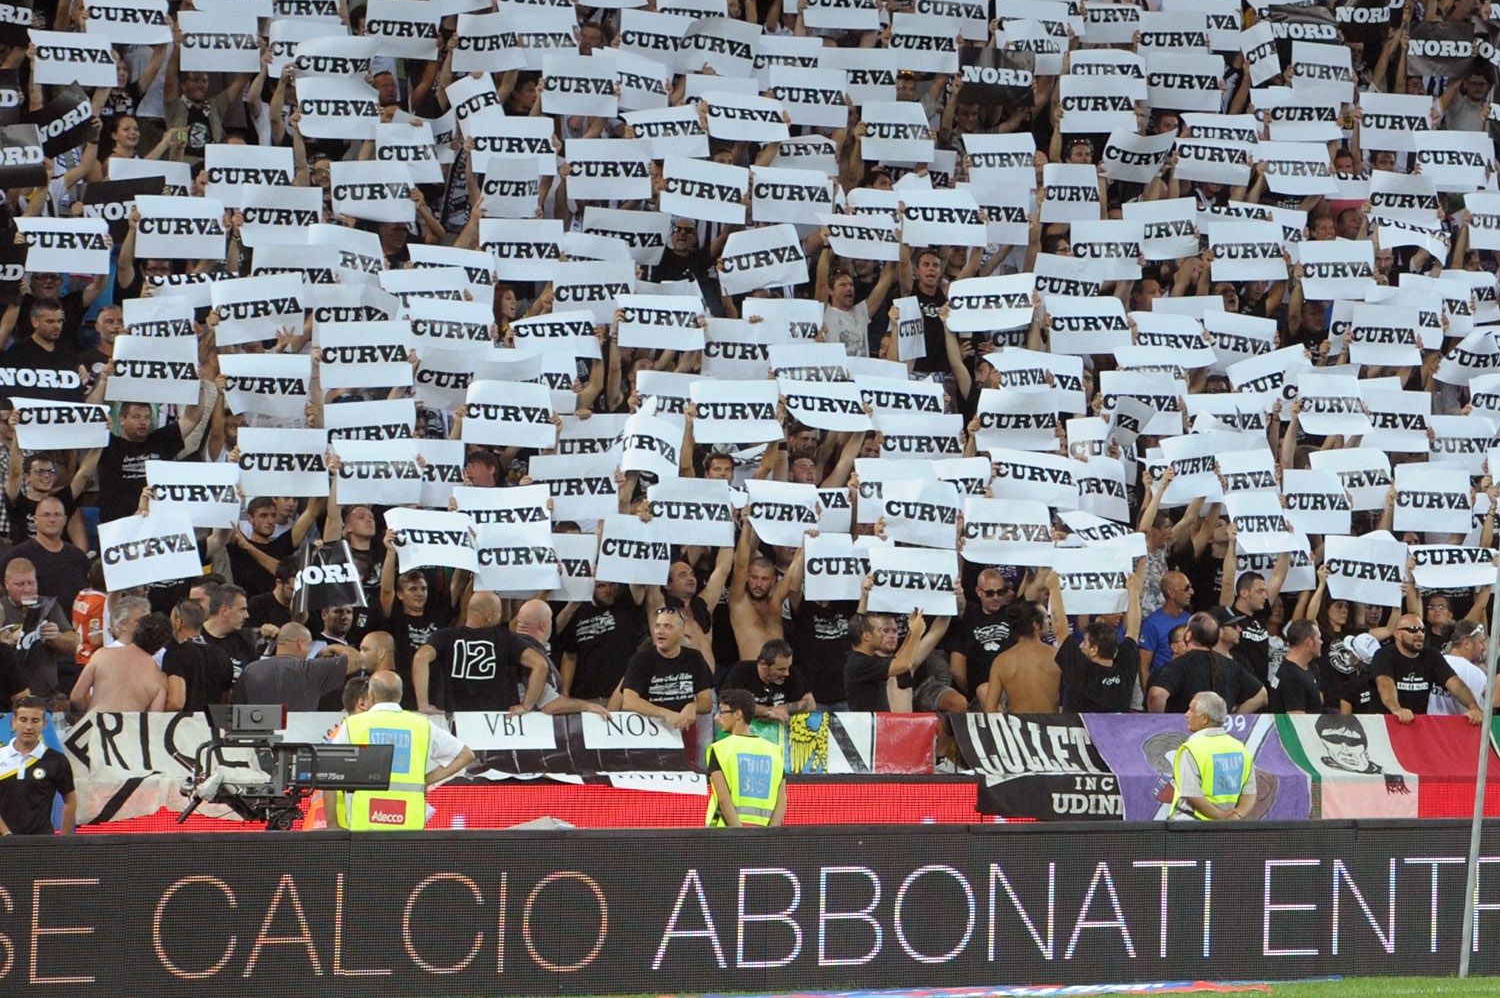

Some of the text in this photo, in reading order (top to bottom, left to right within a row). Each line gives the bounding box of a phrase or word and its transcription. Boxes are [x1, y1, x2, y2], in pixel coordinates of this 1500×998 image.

[88, 6, 164, 25] CURVA
[1147, 73, 1221, 90] CURVA
[1062, 96, 1133, 111] CURVA
[709, 104, 782, 123] CURVA
[1178, 145, 1247, 163] CURVA
[208, 168, 291, 186] CURVA
[568, 161, 648, 177] CURVA
[666, 178, 741, 205] CURVA
[754, 183, 831, 203] CURVA
[905, 205, 987, 224] CURVA
[139, 214, 224, 235] CURVA
[22, 231, 108, 250] CURVA
[1073, 242, 1144, 258] CURVA
[217, 297, 303, 321] CURVA
[515, 321, 594, 337] CURVA
[1051, 316, 1128, 331] CURVA
[1137, 331, 1206, 349] CURVA
[113, 360, 199, 380] CURVA
[696, 403, 775, 419] CURVA
[786, 395, 861, 414] CURVA
[860, 390, 942, 414] CURVA
[17, 407, 109, 425] CURVA
[147, 484, 238, 503] CURVA
[1395, 491, 1470, 510] CURVA
[392, 527, 472, 547] CURVA
[1414, 549, 1494, 565] CURVA
[875, 570, 954, 591] CURVA
[1324, 559, 1402, 583] CURVA
[451, 639, 496, 680] 12
[484, 713, 660, 738] VBI NOS
[371, 810, 404, 823] Adecco
[153, 870, 608, 978] CALCIO
[652, 860, 1212, 972] ABBONATI
